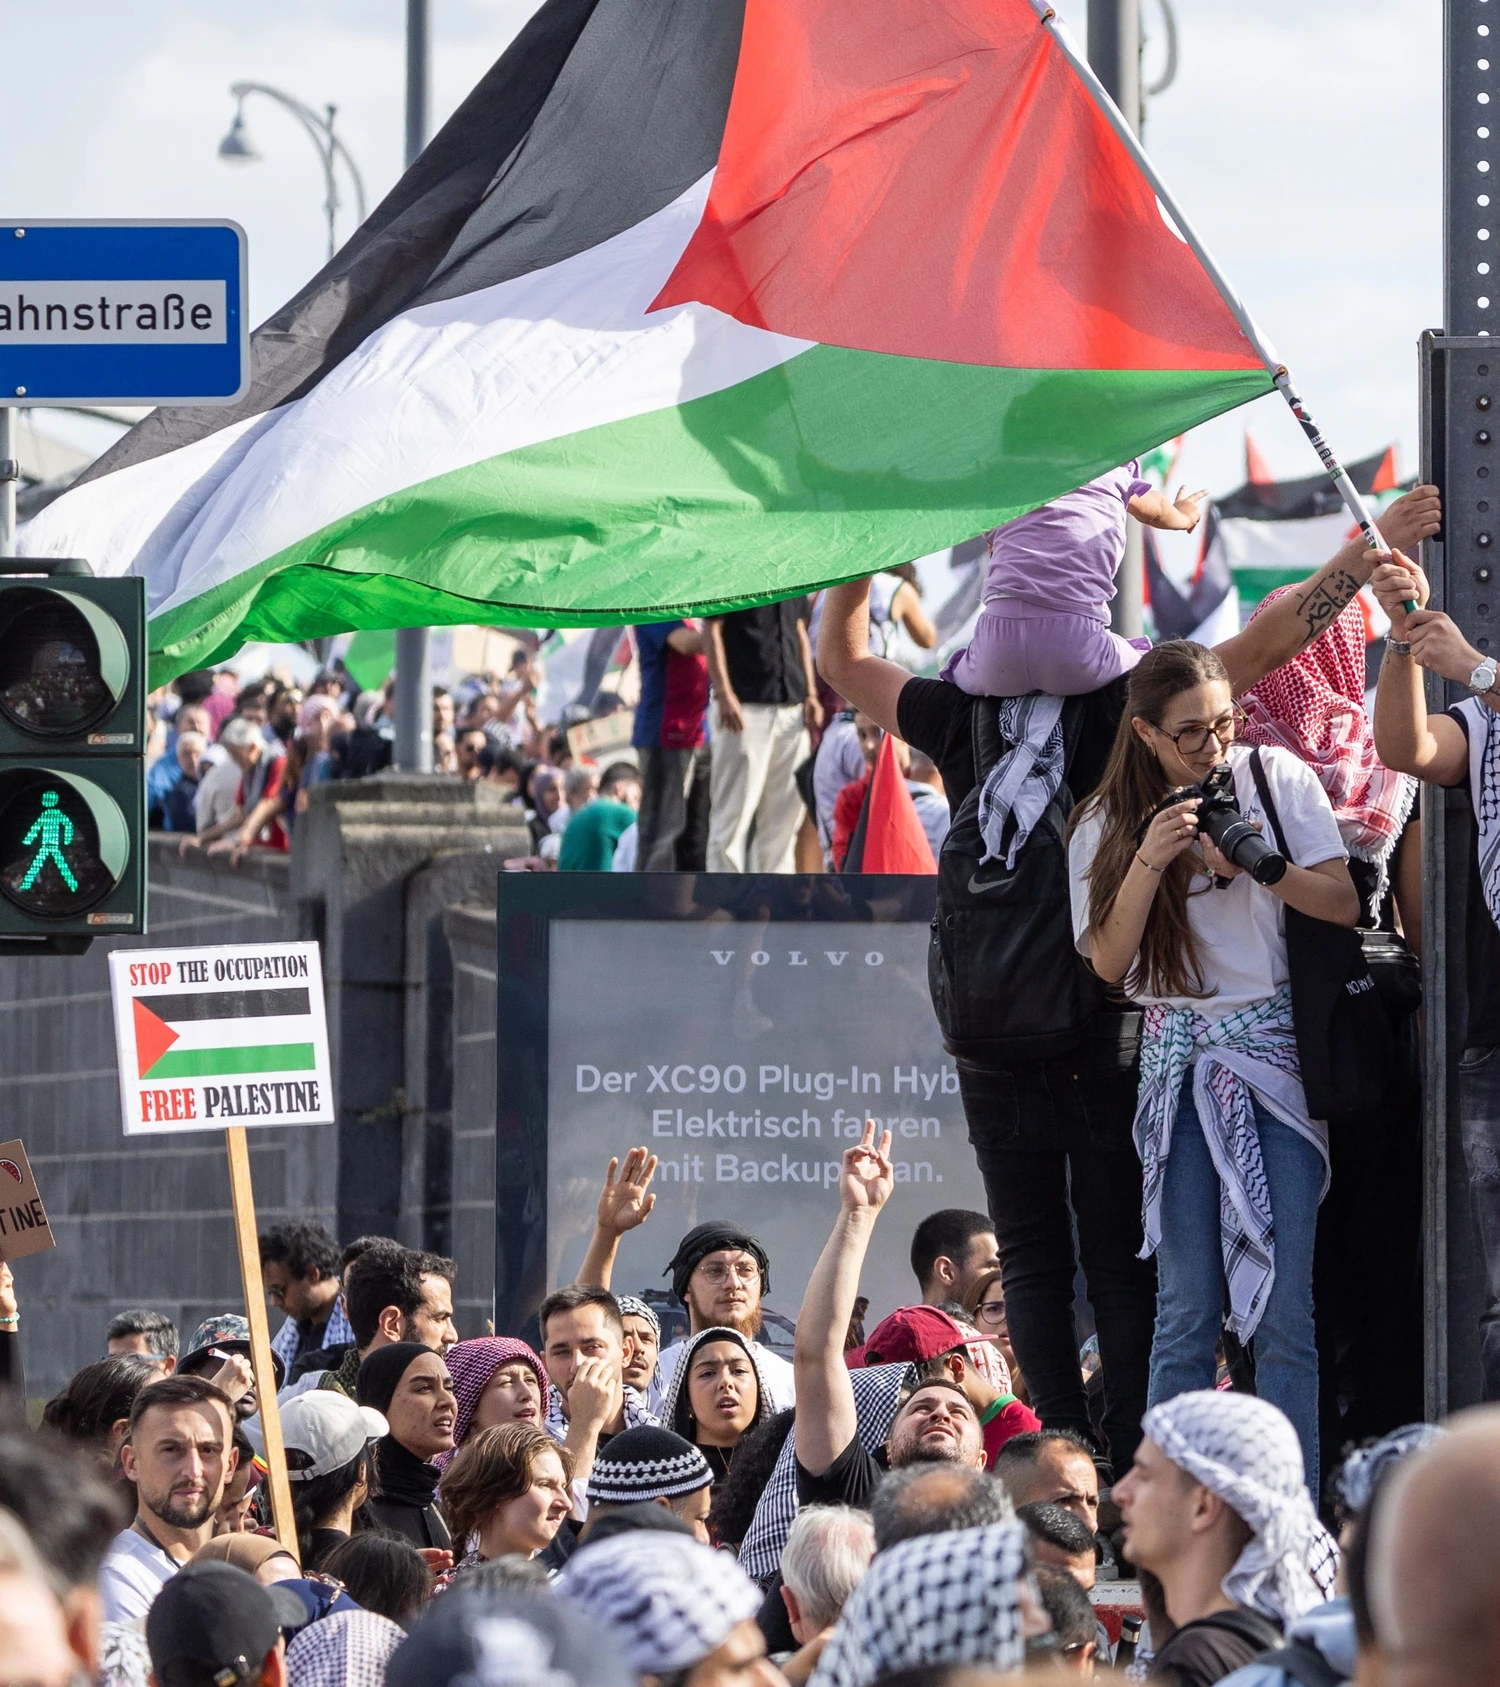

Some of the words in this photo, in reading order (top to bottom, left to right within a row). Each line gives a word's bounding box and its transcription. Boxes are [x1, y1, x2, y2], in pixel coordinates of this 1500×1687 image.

[0, 293, 212, 330] ahnstraße
[129, 962, 171, 986] STOP
[176, 960, 209, 983] THE
[214, 955, 309, 981] OCCUPATION
[710, 950, 884, 966] VOLVO
[576, 1065, 637, 1093] Der
[646, 1065, 746, 1093] XC90
[759, 1064, 881, 1101] Plug-In
[139, 1087, 197, 1122] FREE
[203, 1080, 321, 1118] PALESTINE
[652, 1108, 821, 1138] Elektrisch
[831, 1109, 940, 1138] fahren
[652, 1153, 704, 1183] mit
